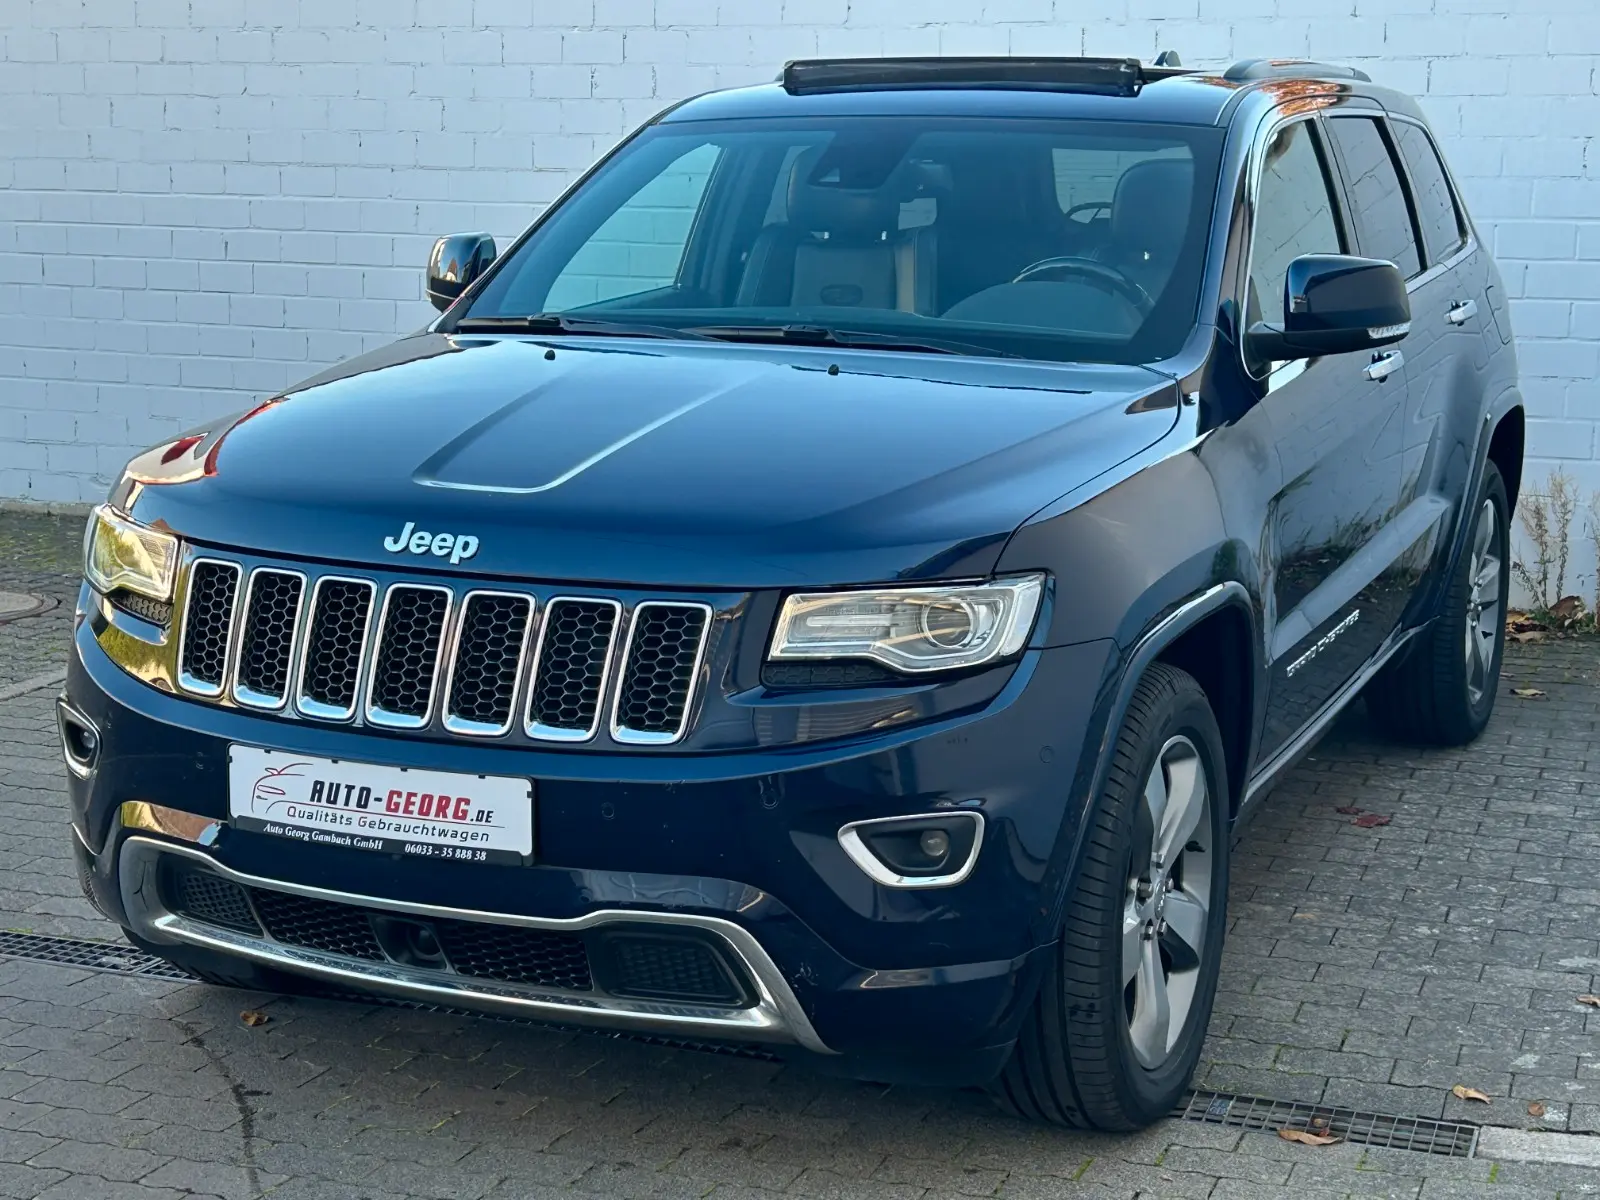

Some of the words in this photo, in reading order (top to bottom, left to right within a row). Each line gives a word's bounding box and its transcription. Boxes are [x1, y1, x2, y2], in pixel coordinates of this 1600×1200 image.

[383, 521, 479, 564] Jeep
[309, 780, 494, 824] AUTO-GEORG.DE
[263, 823, 283, 835] Auto
[285, 826, 309, 842] Georg
[353, 837, 383, 850] GmbH
[287, 806, 352, 826] Qualitäts
[357, 816, 490, 842] Gebrauchtwagen
[404, 843, 433, 856] 06033
[441, 847, 453, 858] 35
[455, 849, 472, 861] 888
[474, 850, 487, 862] 38
